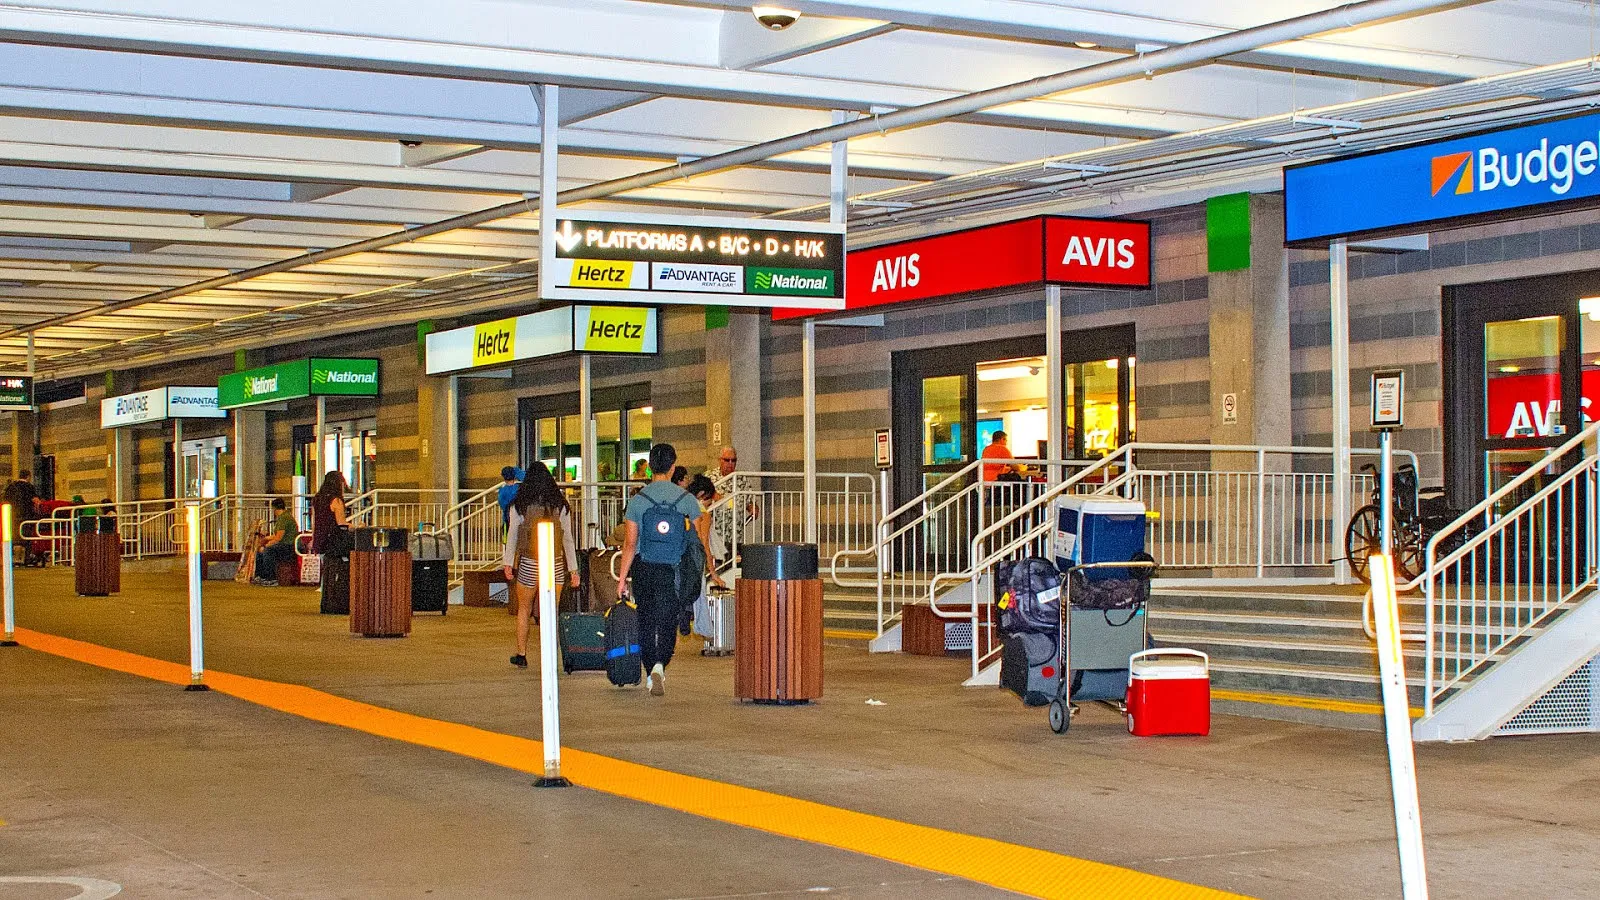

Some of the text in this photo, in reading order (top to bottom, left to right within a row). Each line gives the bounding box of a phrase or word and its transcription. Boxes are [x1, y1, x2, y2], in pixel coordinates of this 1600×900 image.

[1479, 132, 1600, 195] Budge
[586, 229, 825, 259] PLATFORMS A B/C D H/K
[1062, 236, 1135, 269] AVIS
[577, 265, 626, 282] Hertz
[667, 268, 736, 283] ADVANTAGE
[871, 253, 920, 293] AVIS
[477, 328, 510, 358] Hertz
[589, 320, 643, 339] Hertz
[177, 396, 219, 405] ADVANTAG
